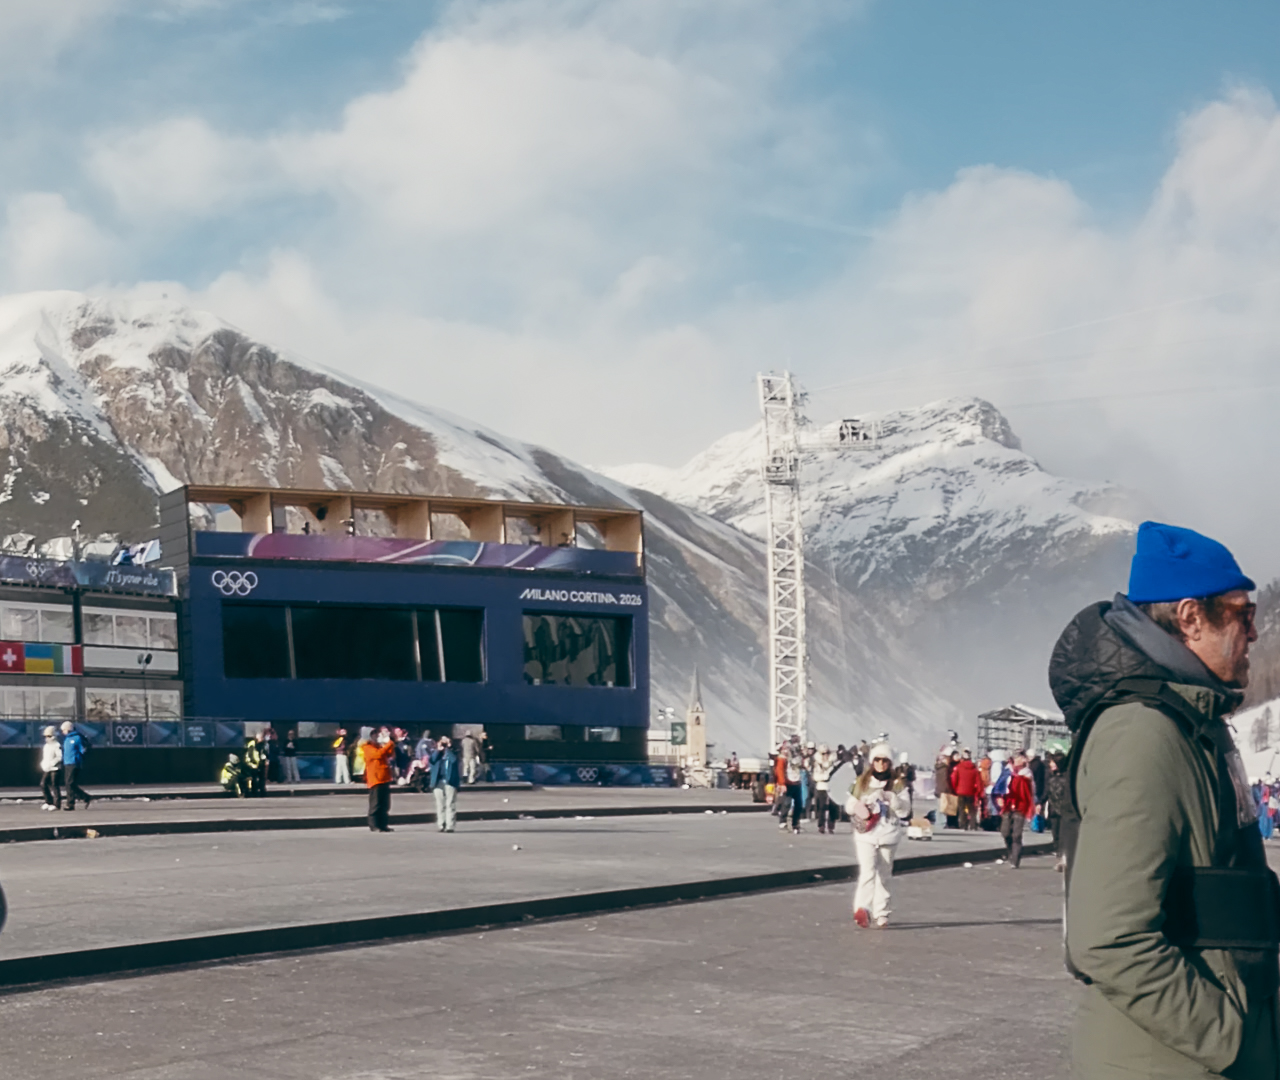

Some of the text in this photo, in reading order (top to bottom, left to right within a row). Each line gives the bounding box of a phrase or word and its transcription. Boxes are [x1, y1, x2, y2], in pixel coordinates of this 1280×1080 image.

[519, 588, 643, 606] MILANO CORTINA 2026
